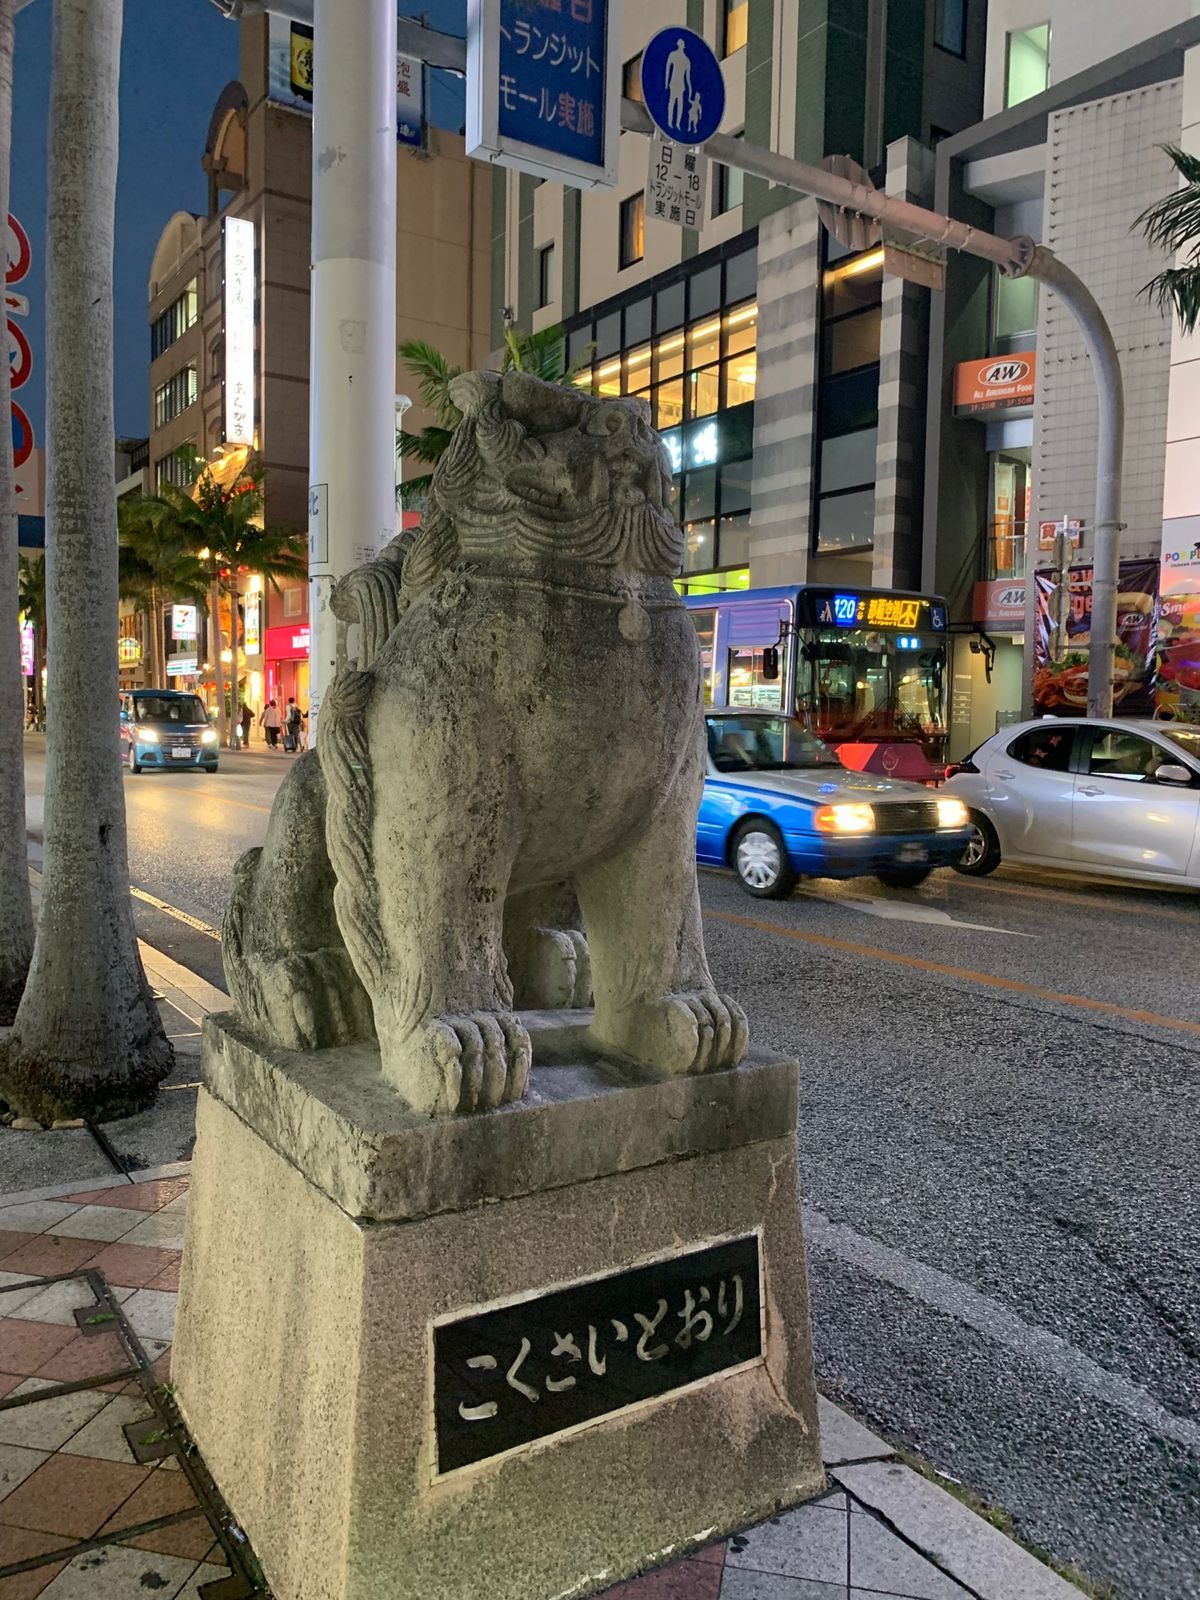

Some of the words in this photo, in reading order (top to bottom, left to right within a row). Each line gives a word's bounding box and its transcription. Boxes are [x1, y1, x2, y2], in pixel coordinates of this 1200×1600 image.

[500, 74, 595, 137] モール実施
[988, 364, 1020, 382] AW
[834, 598, 856, 619] 120
[458, 1274, 744, 1421] こくさいとおり
